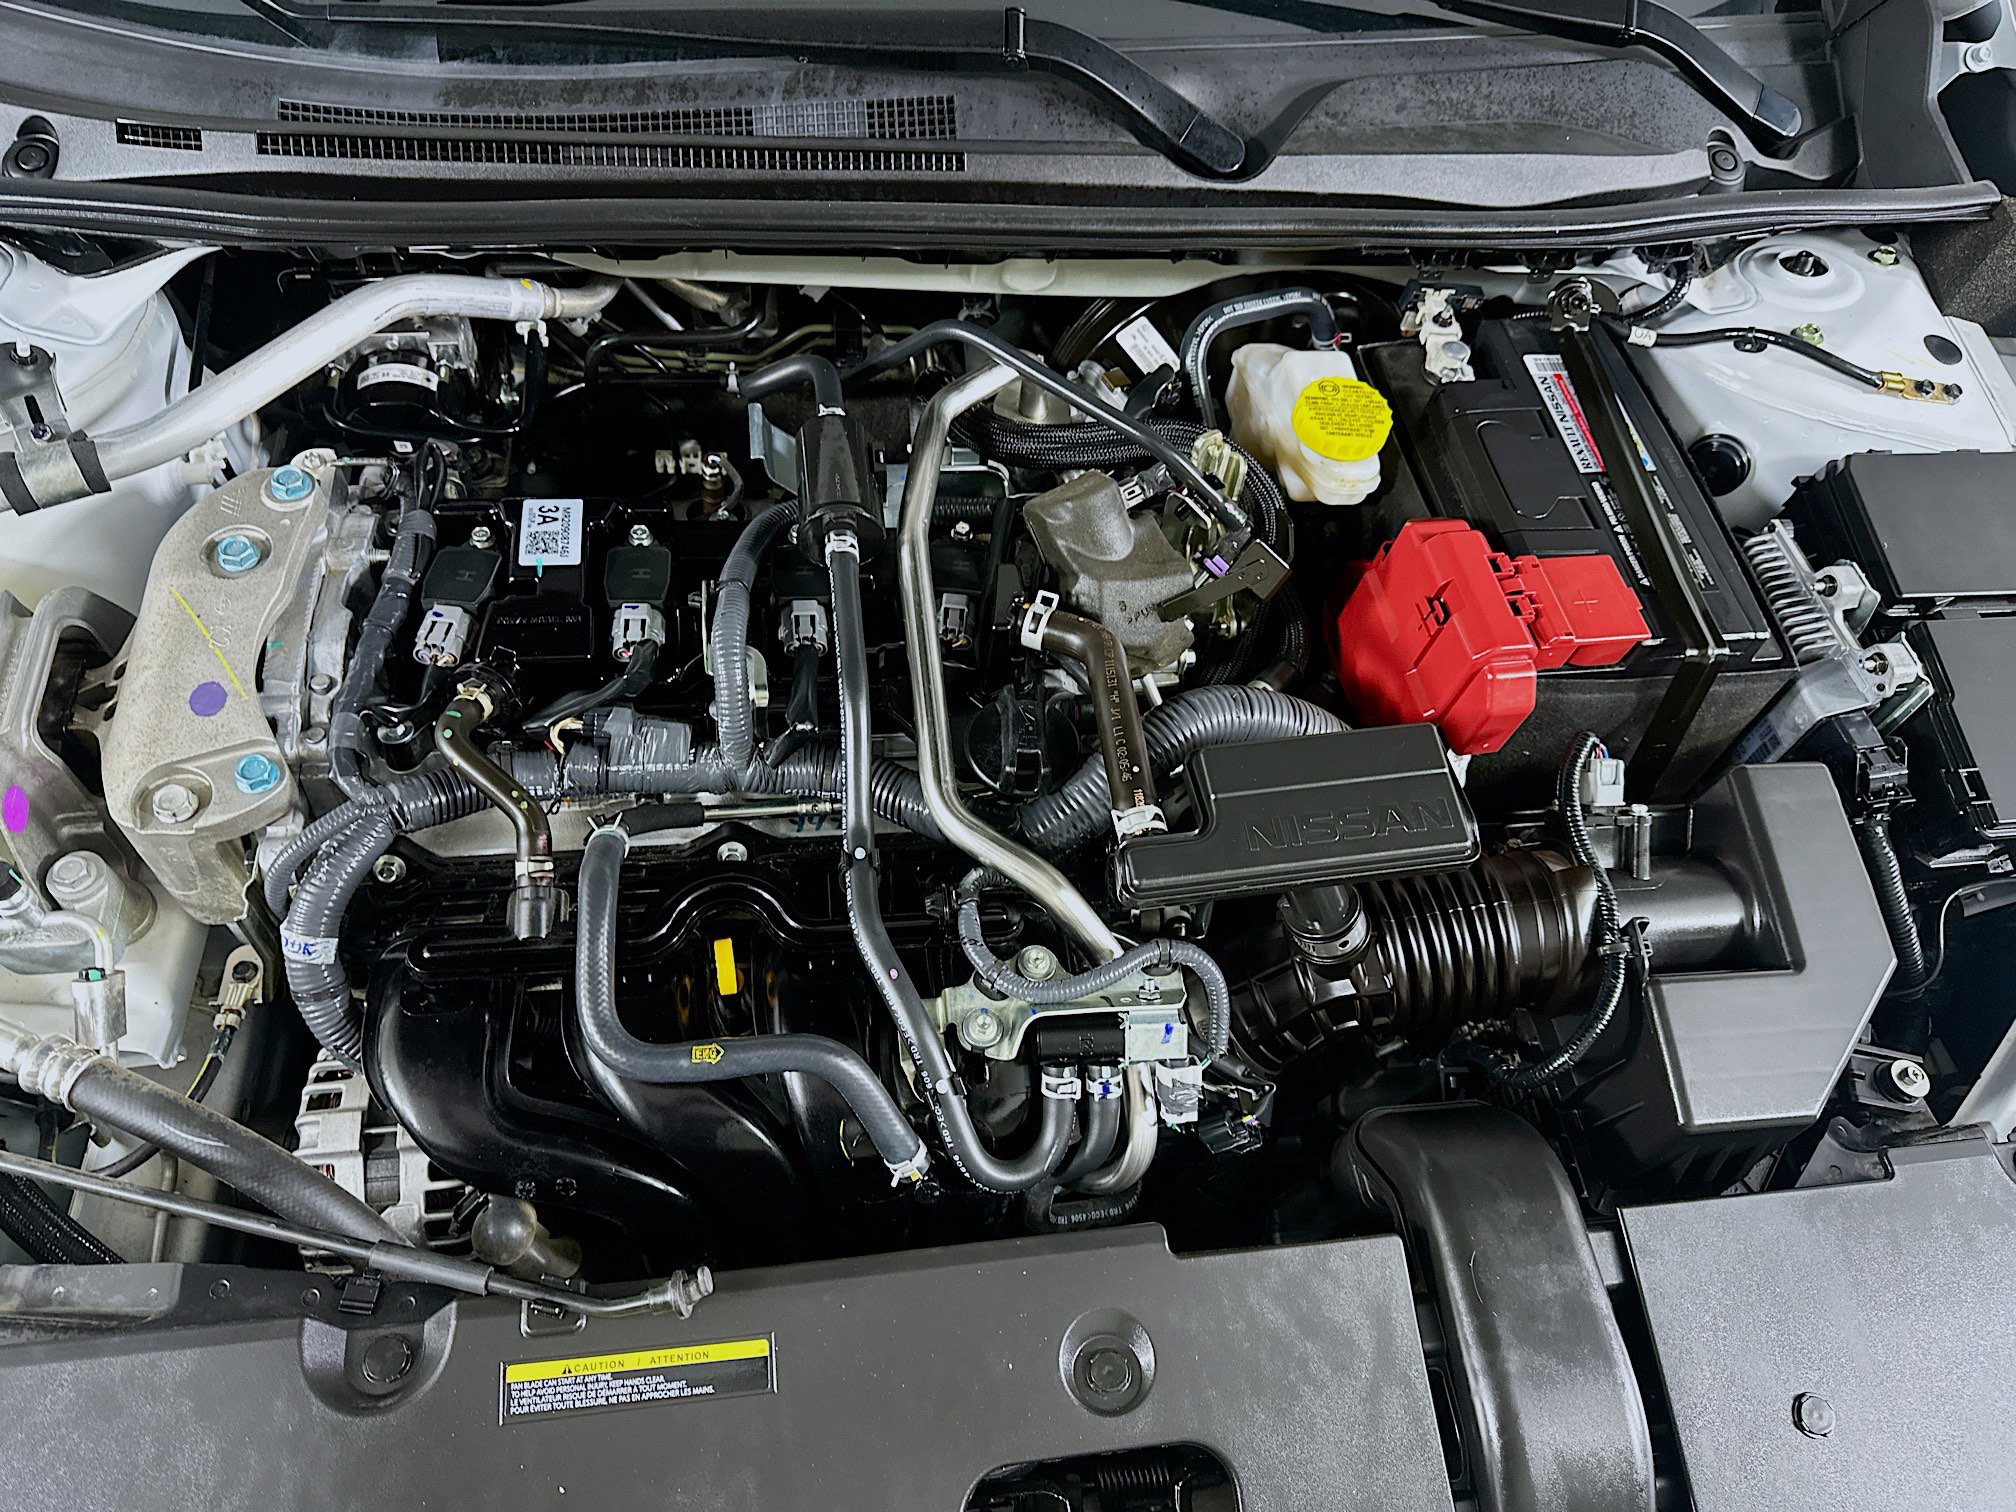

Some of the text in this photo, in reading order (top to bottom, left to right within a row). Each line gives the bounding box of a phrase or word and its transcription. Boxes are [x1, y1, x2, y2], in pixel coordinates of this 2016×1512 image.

[1538, 375, 1569, 424] NISSAN
[1562, 418, 1593, 470] RENAULT
[538, 505, 560, 526] 3A
[1244, 797, 1454, 851] NISSAN
[574, 1360, 625, 1372] CAUTION
[650, 1351, 710, 1365] ATTENTION
[510, 1382, 523, 1390] FAN
[524, 1380, 543, 1389] BLADE
[544, 1379, 557, 1387] CAN
[558, 1377, 575, 1386] START
[518, 1393, 562, 1406] VENTILATEUR
[563, 1391, 586, 1401] RISQUE
[587, 1390, 596, 1398] DE
[639, 1383, 656, 1392] TOUT
[522, 1389, 535, 1397] HELP
[536, 1387, 555, 1396] AVOID
[556, 1384, 586, 1394] PERSONAL
[608, 1380, 623, 1388] KEEP
[624, 1378, 645, 1387] HANDS
[510, 1406, 529, 1415] POUR
[553, 1401, 574, 1410] TOUTE
[608, 1396, 617, 1404] NE
[618, 1394, 631, 1403] PAS
[642, 1388, 680, 1401] APPROCHER
[681, 1387, 691, 1396] LES
